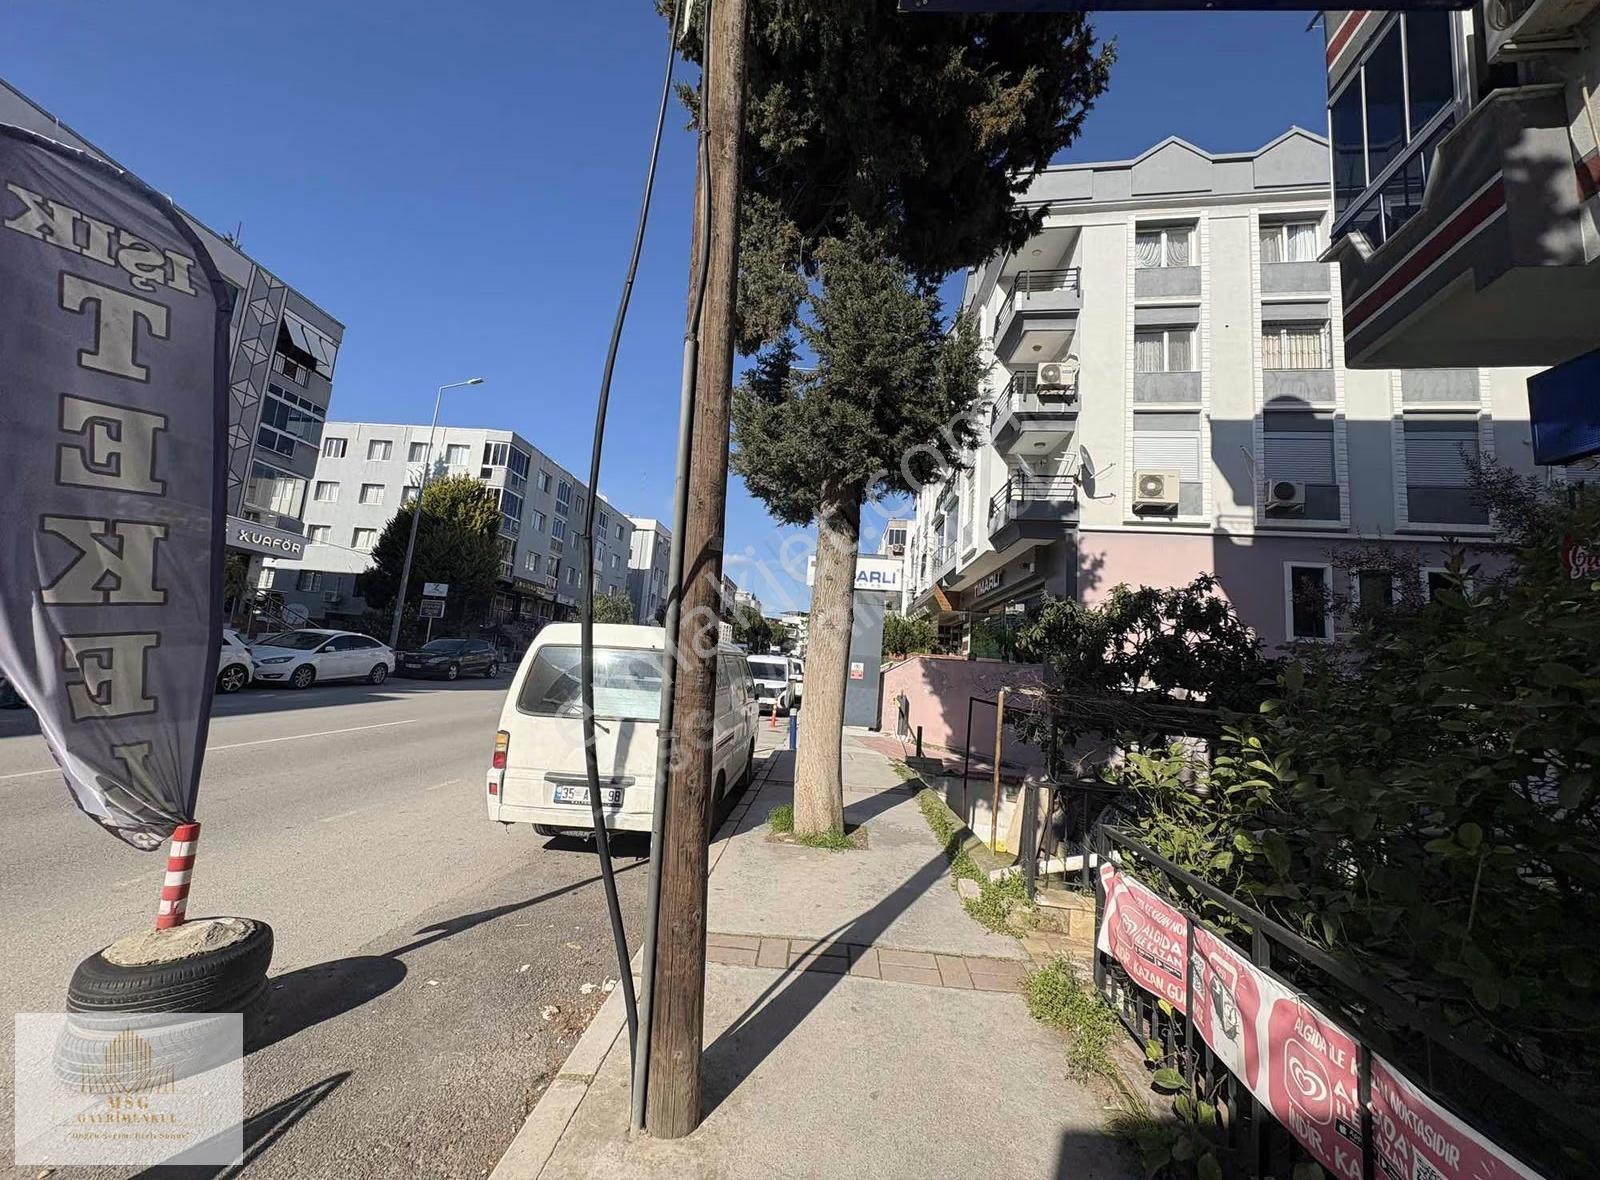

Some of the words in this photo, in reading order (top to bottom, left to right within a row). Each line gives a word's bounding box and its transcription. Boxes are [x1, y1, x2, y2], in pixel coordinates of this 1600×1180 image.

[855, 571, 896, 584] ARLI
[562, 787, 575, 800] 35
[1334, 1145, 1362, 1180] KA
